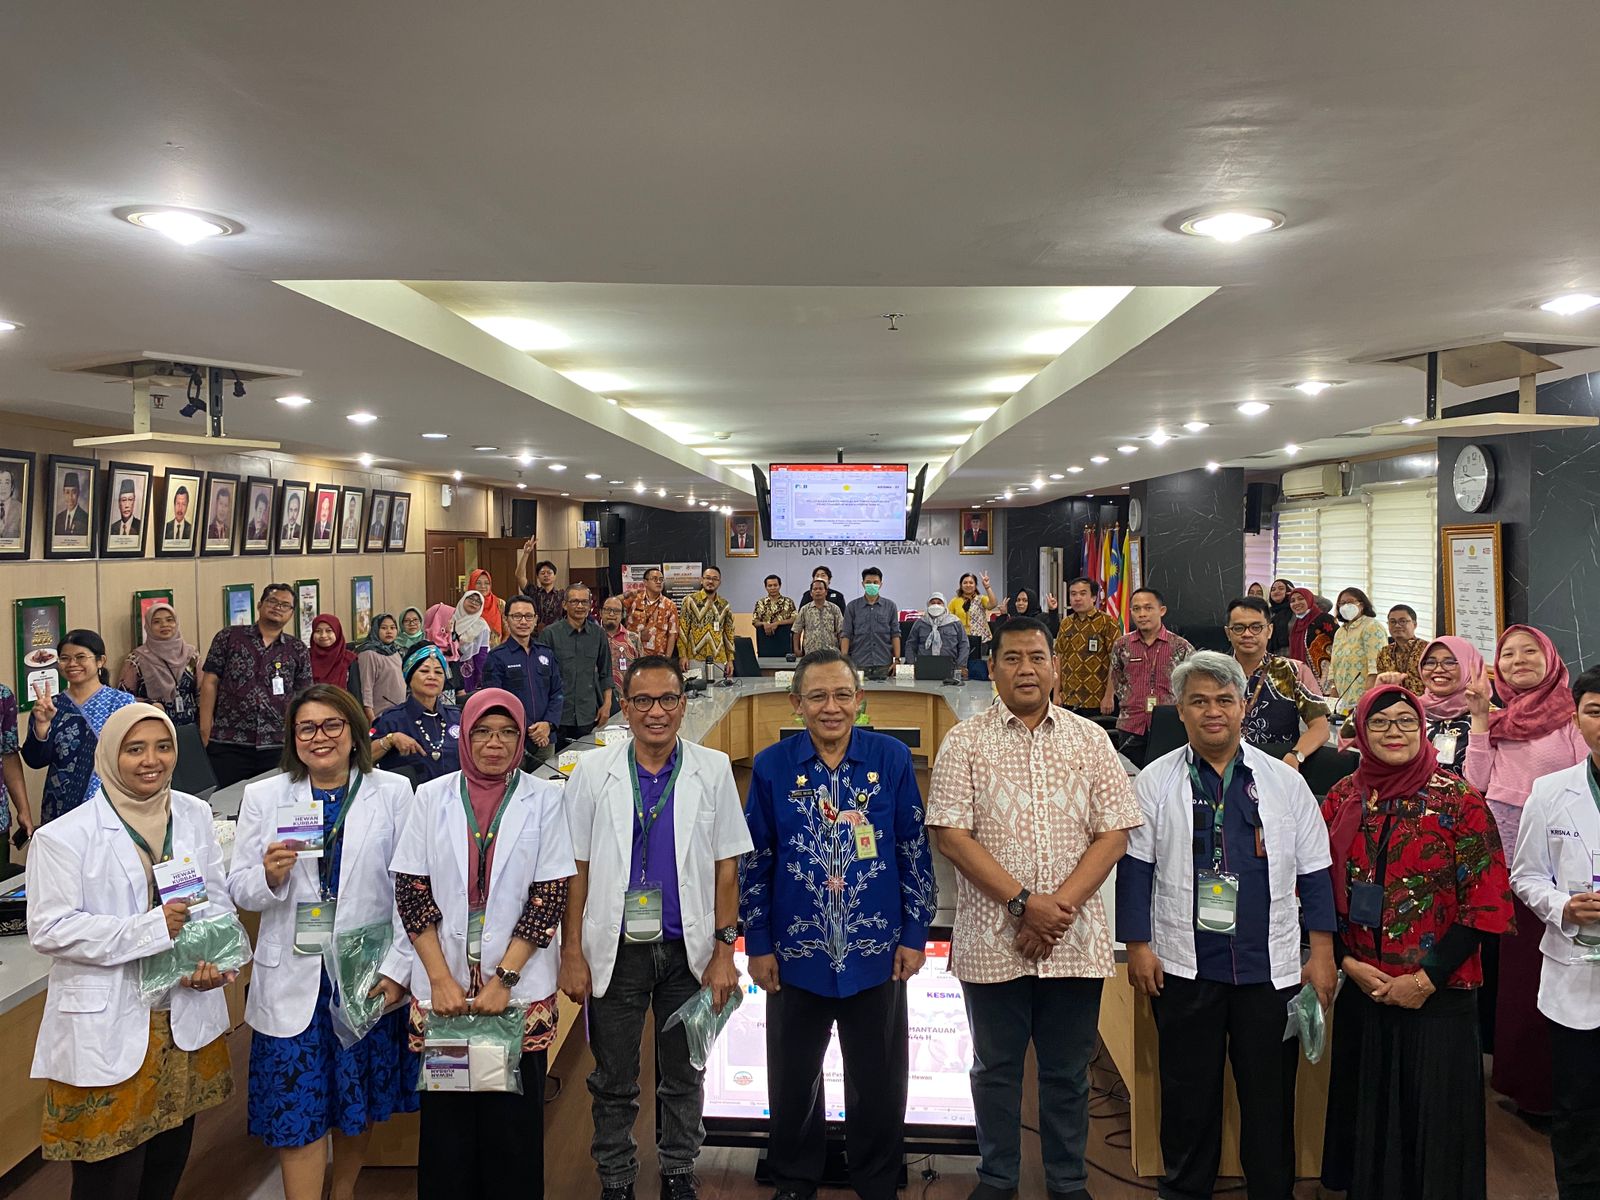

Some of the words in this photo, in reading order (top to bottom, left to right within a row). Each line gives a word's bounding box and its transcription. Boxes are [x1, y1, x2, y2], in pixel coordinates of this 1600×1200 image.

[802, 548, 822, 556] DAN
[885, 546, 920, 555] HEWAN
[173, 869, 196, 879] HEWAN
[926, 991, 962, 999] KESMA
[908, 1026, 956, 1034] MANTAUAN
